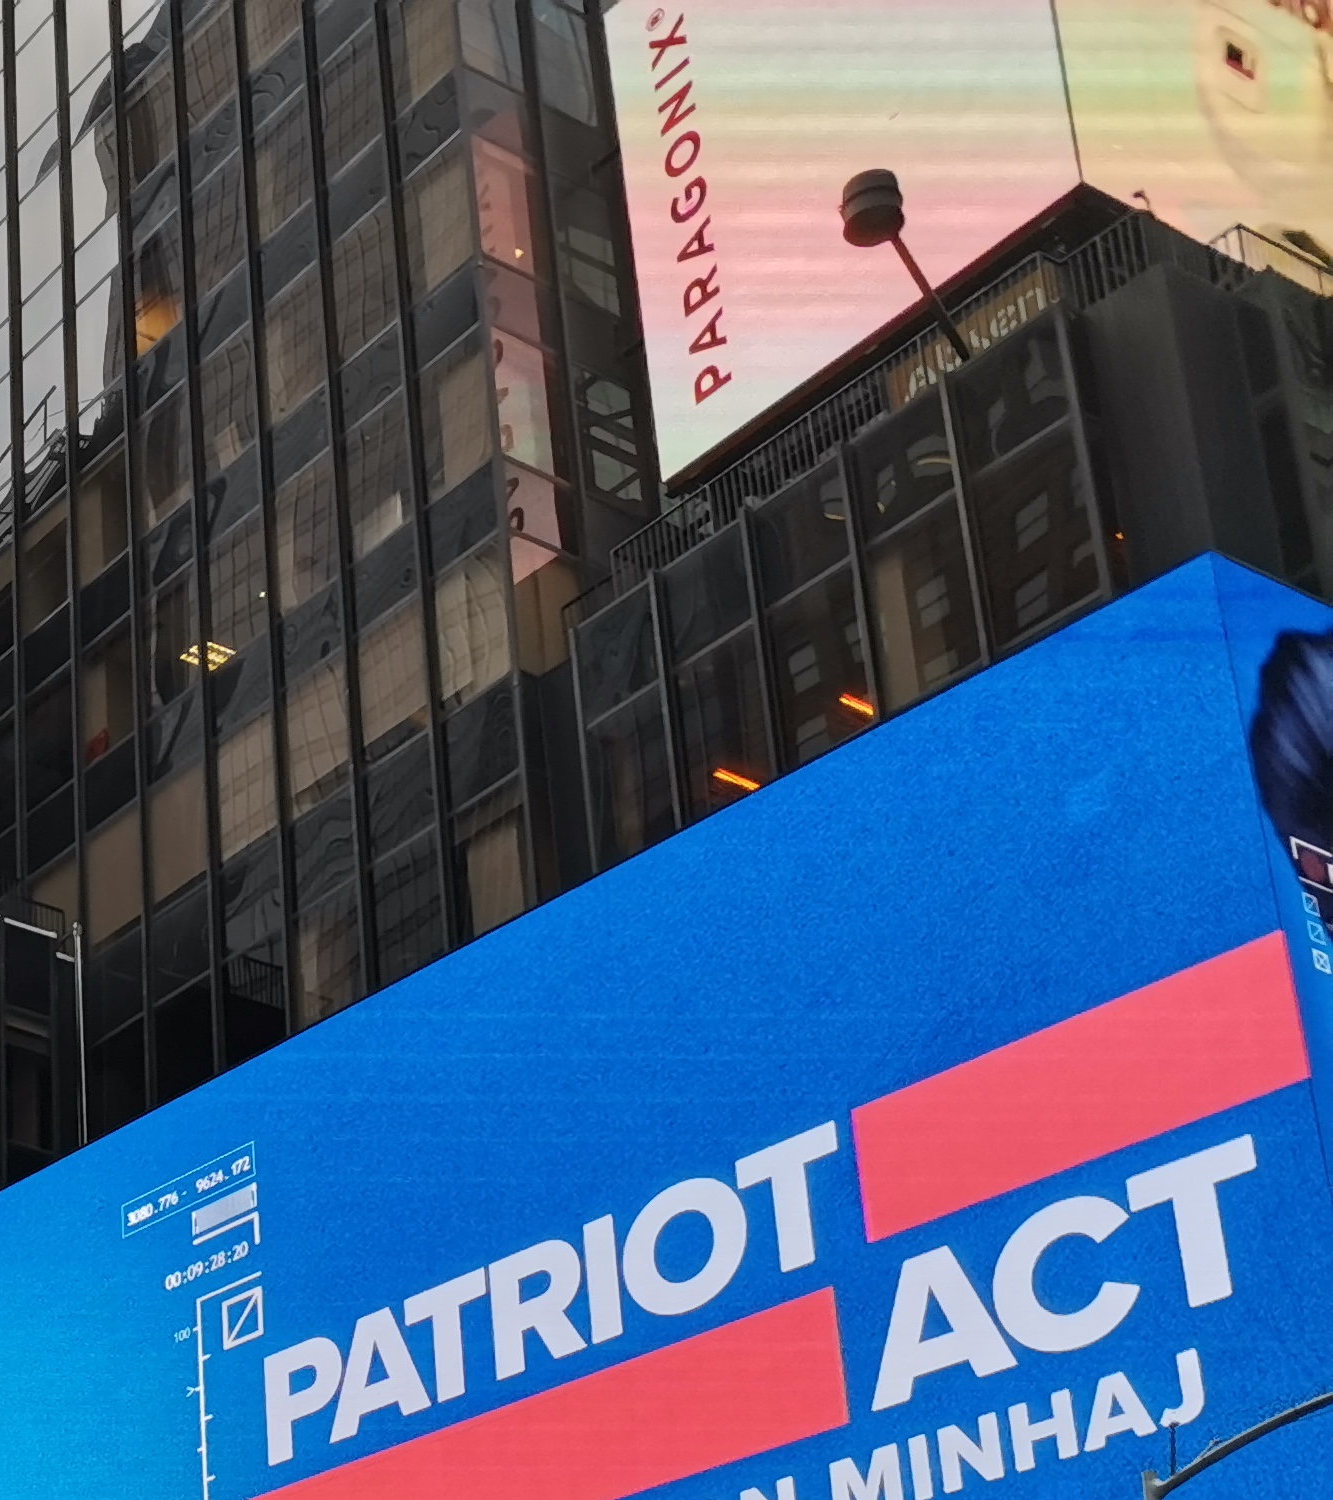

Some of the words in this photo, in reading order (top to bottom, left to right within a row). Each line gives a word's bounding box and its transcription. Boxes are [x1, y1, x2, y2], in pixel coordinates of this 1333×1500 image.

[165, 1240, 249, 1291] 00:09:28:20
[263, 1120, 838, 1467] PATRIOT
[871, 1134, 1257, 1412] ACT
